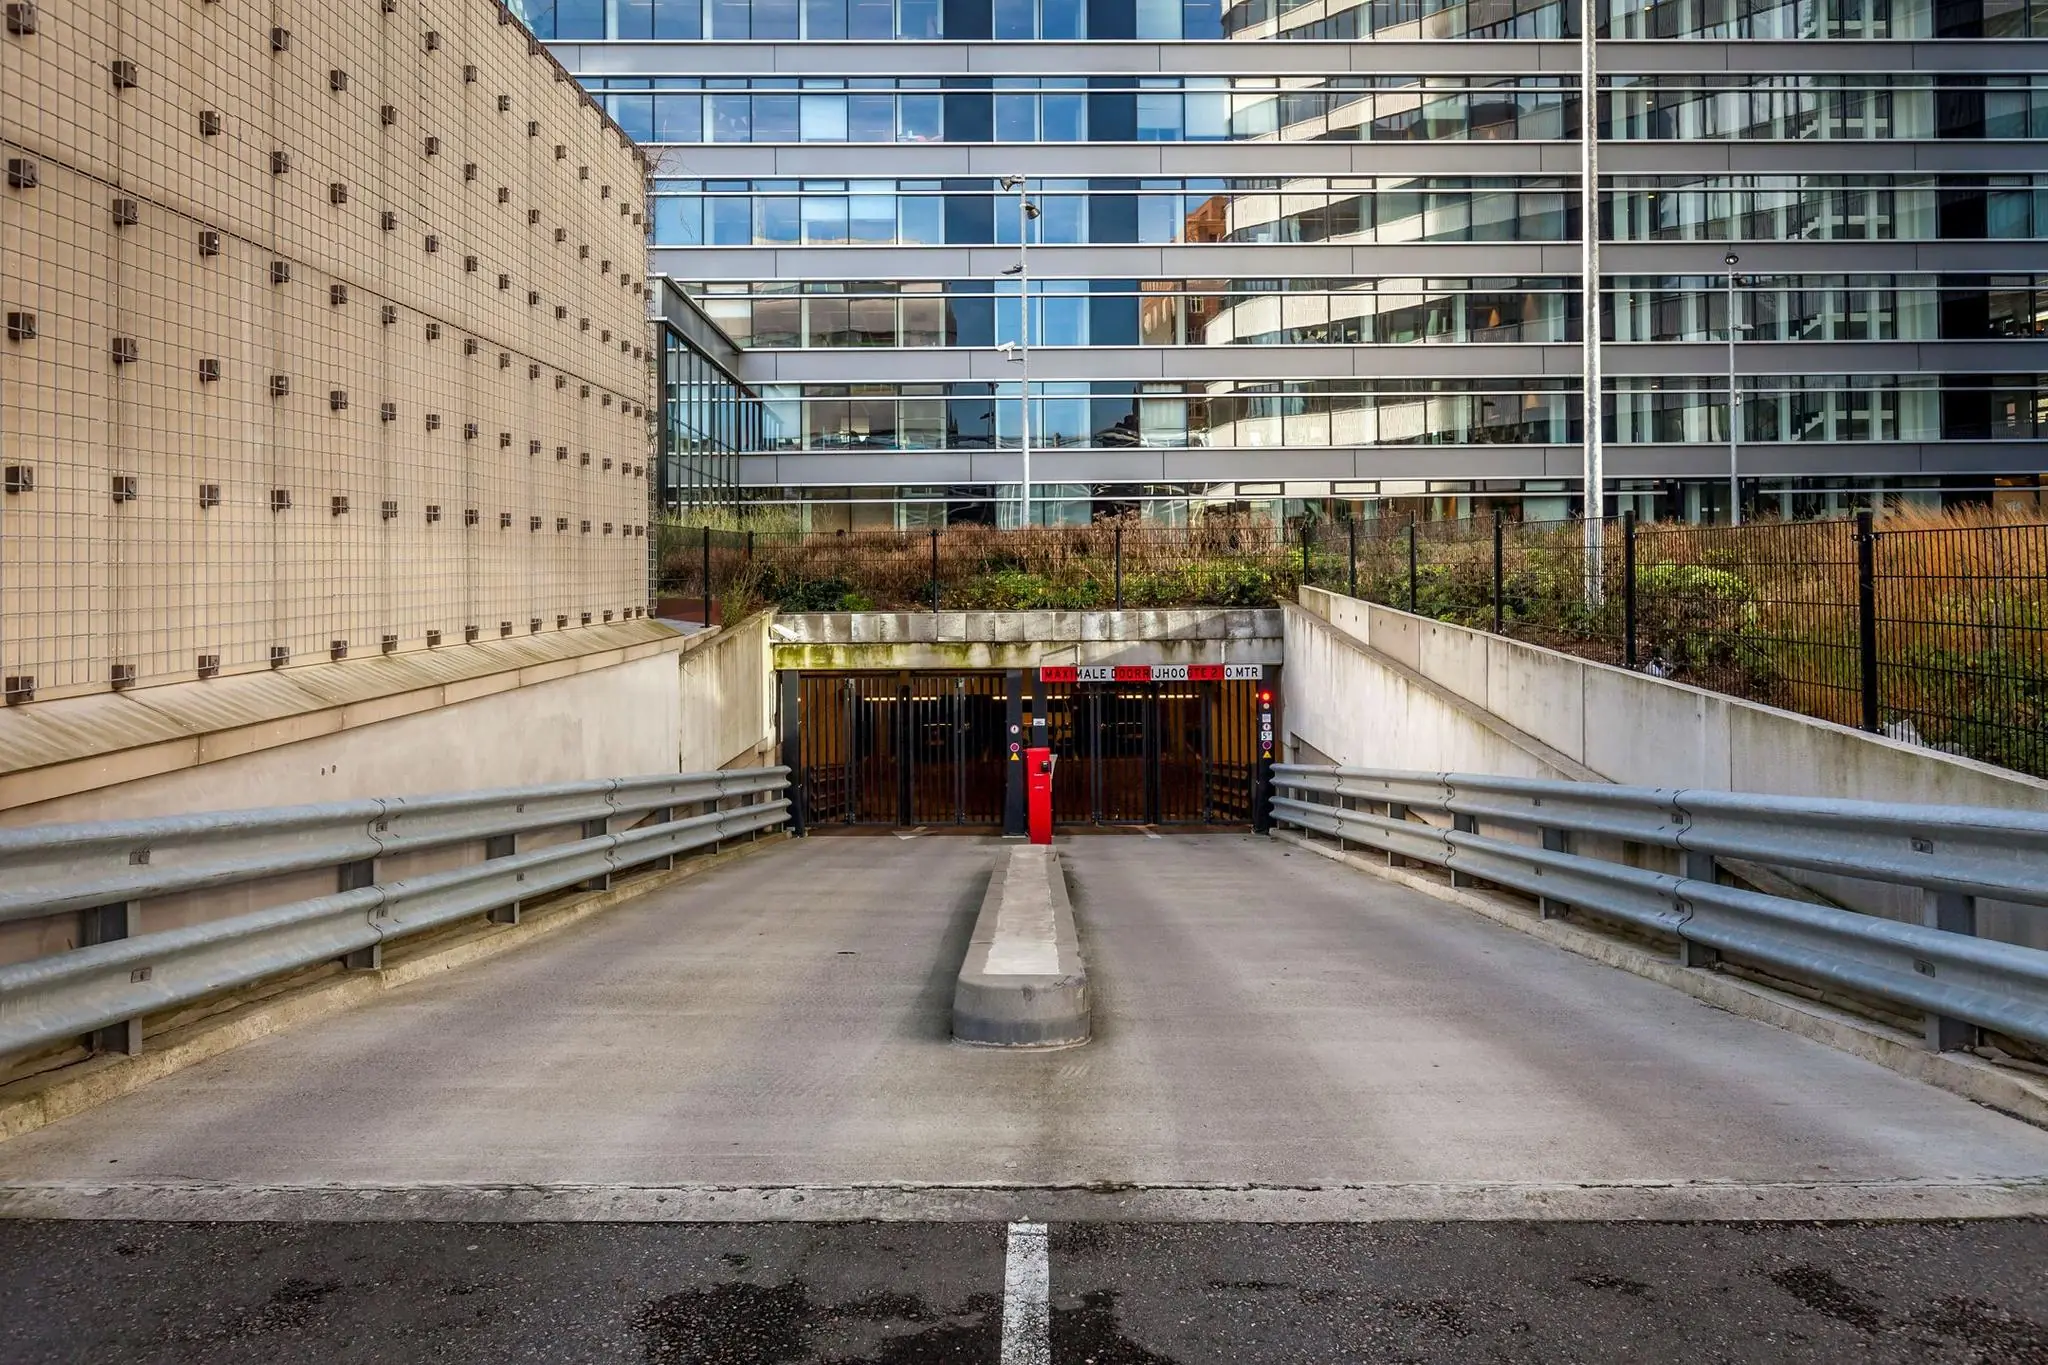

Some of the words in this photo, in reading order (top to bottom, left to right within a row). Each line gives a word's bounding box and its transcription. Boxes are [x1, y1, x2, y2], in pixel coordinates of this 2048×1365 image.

[1045, 668, 1107, 680] MAXIMALE
[1111, 667, 1207, 680] DOORRIJHOOGTE
[1235, 666, 1259, 679] MTR
